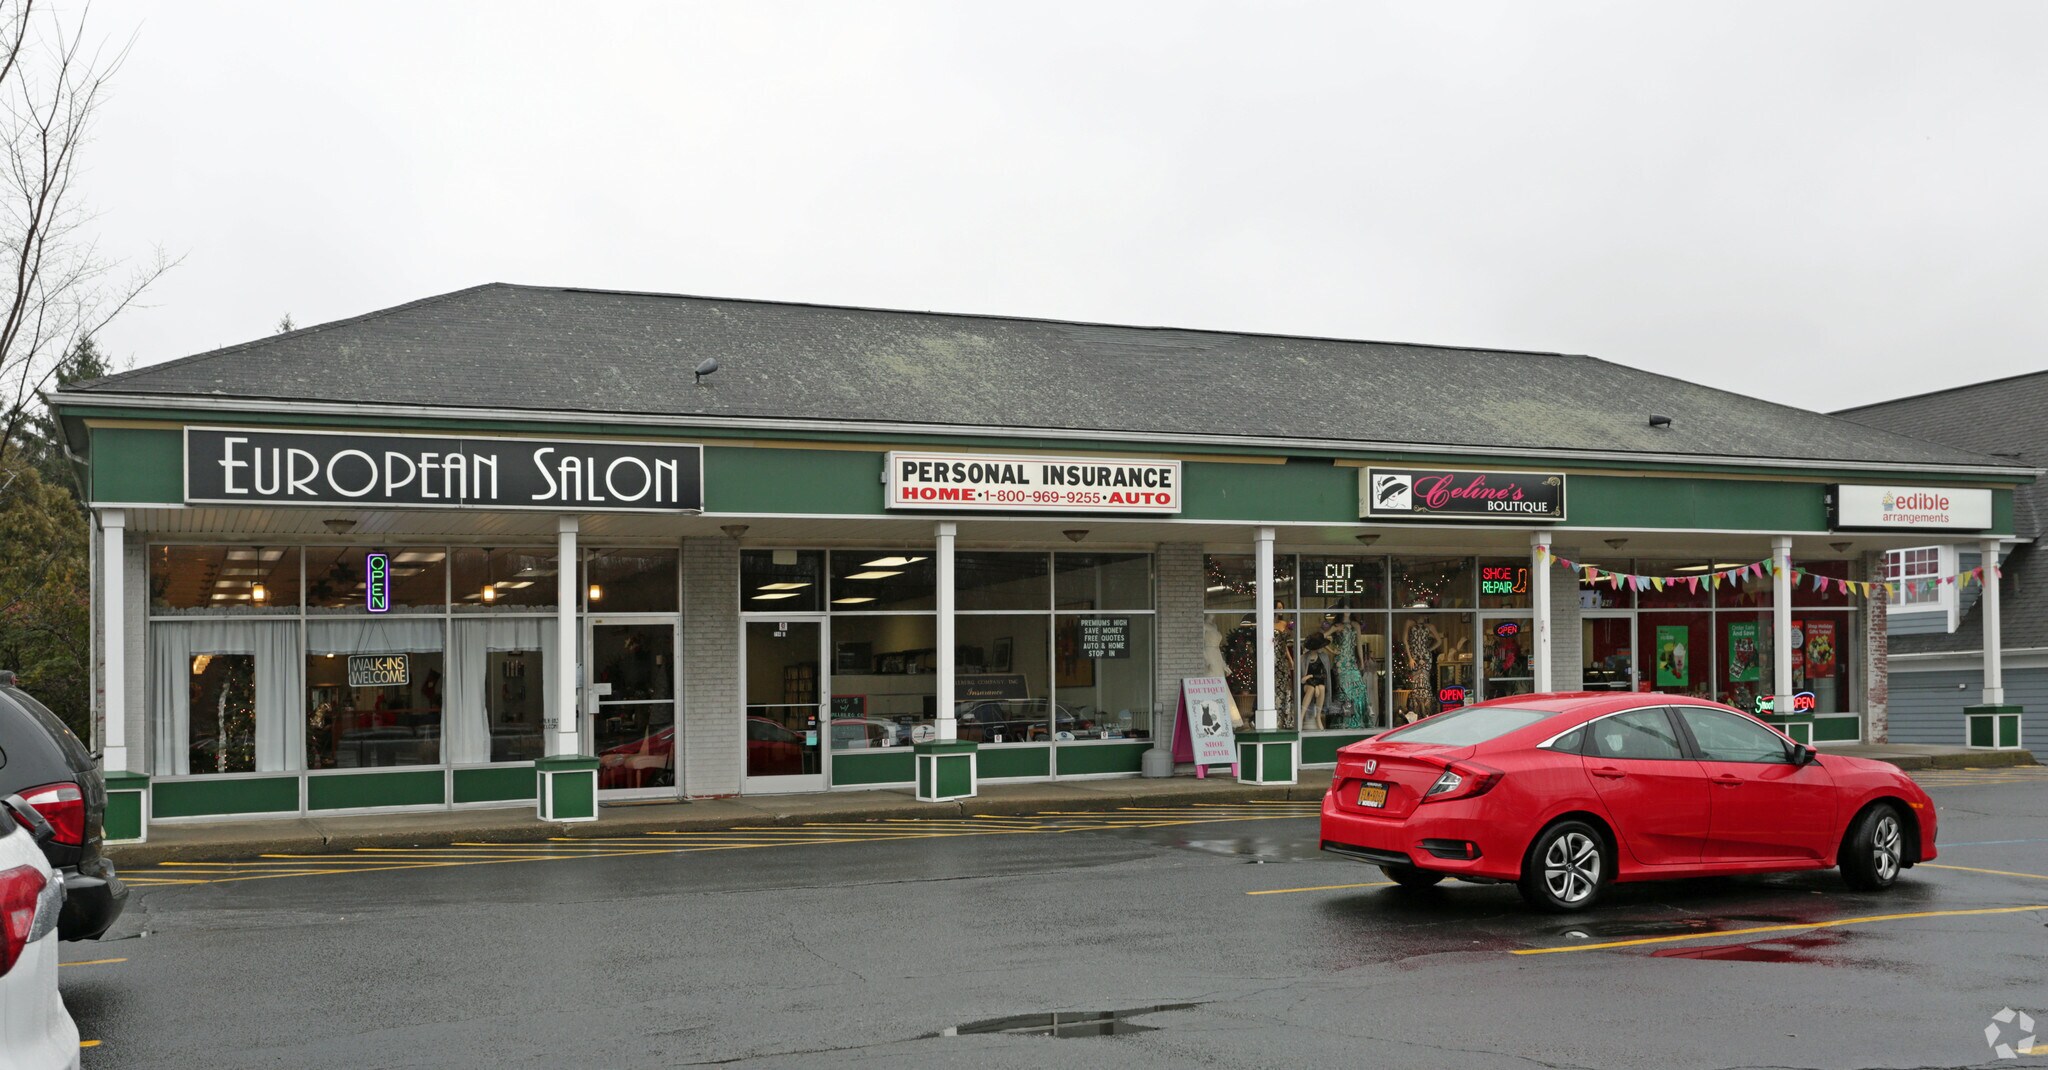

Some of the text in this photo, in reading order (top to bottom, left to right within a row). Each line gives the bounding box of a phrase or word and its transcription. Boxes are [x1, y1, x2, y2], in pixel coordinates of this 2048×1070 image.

[217, 436, 678, 503] EUROPEAN SALON
[902, 461, 1172, 489] PERSONAL INSURANCE
[902, 487, 1171, 505] HOME 1-800-969-9255 AUTO
[1413, 474, 1525, 509] Celine's
[1487, 500, 1548, 514] BOUTIQUE
[1895, 493, 1950, 511] edible
[1882, 512, 1950, 524] arrangements
[1325, 564, 1354, 579] CUT
[1482, 567, 1512, 580] SHOE
[370, 556, 385, 609] OPEN
[1315, 579, 1364, 594] HEELS
[1482, 581, 1513, 594] REPAIR
[1080, 619, 1111, 627] PREMIUMS
[1102, 626, 1123, 634] MONEY
[1084, 634, 1125, 642] FREE QUOTES
[1497, 625, 1518, 637] OPEN
[1082, 642, 1099, 650] AUTO
[1100, 642, 1106, 650] &
[352, 656, 405, 672] WALK-INS
[351, 670, 406, 685] WELCOME
[1188, 677, 1222, 686] CELINE'S
[1188, 686, 1225, 695] BOUTIQUE
[1439, 688, 1464, 702] OPEN
[1202, 750, 1230, 758] REPAIR
